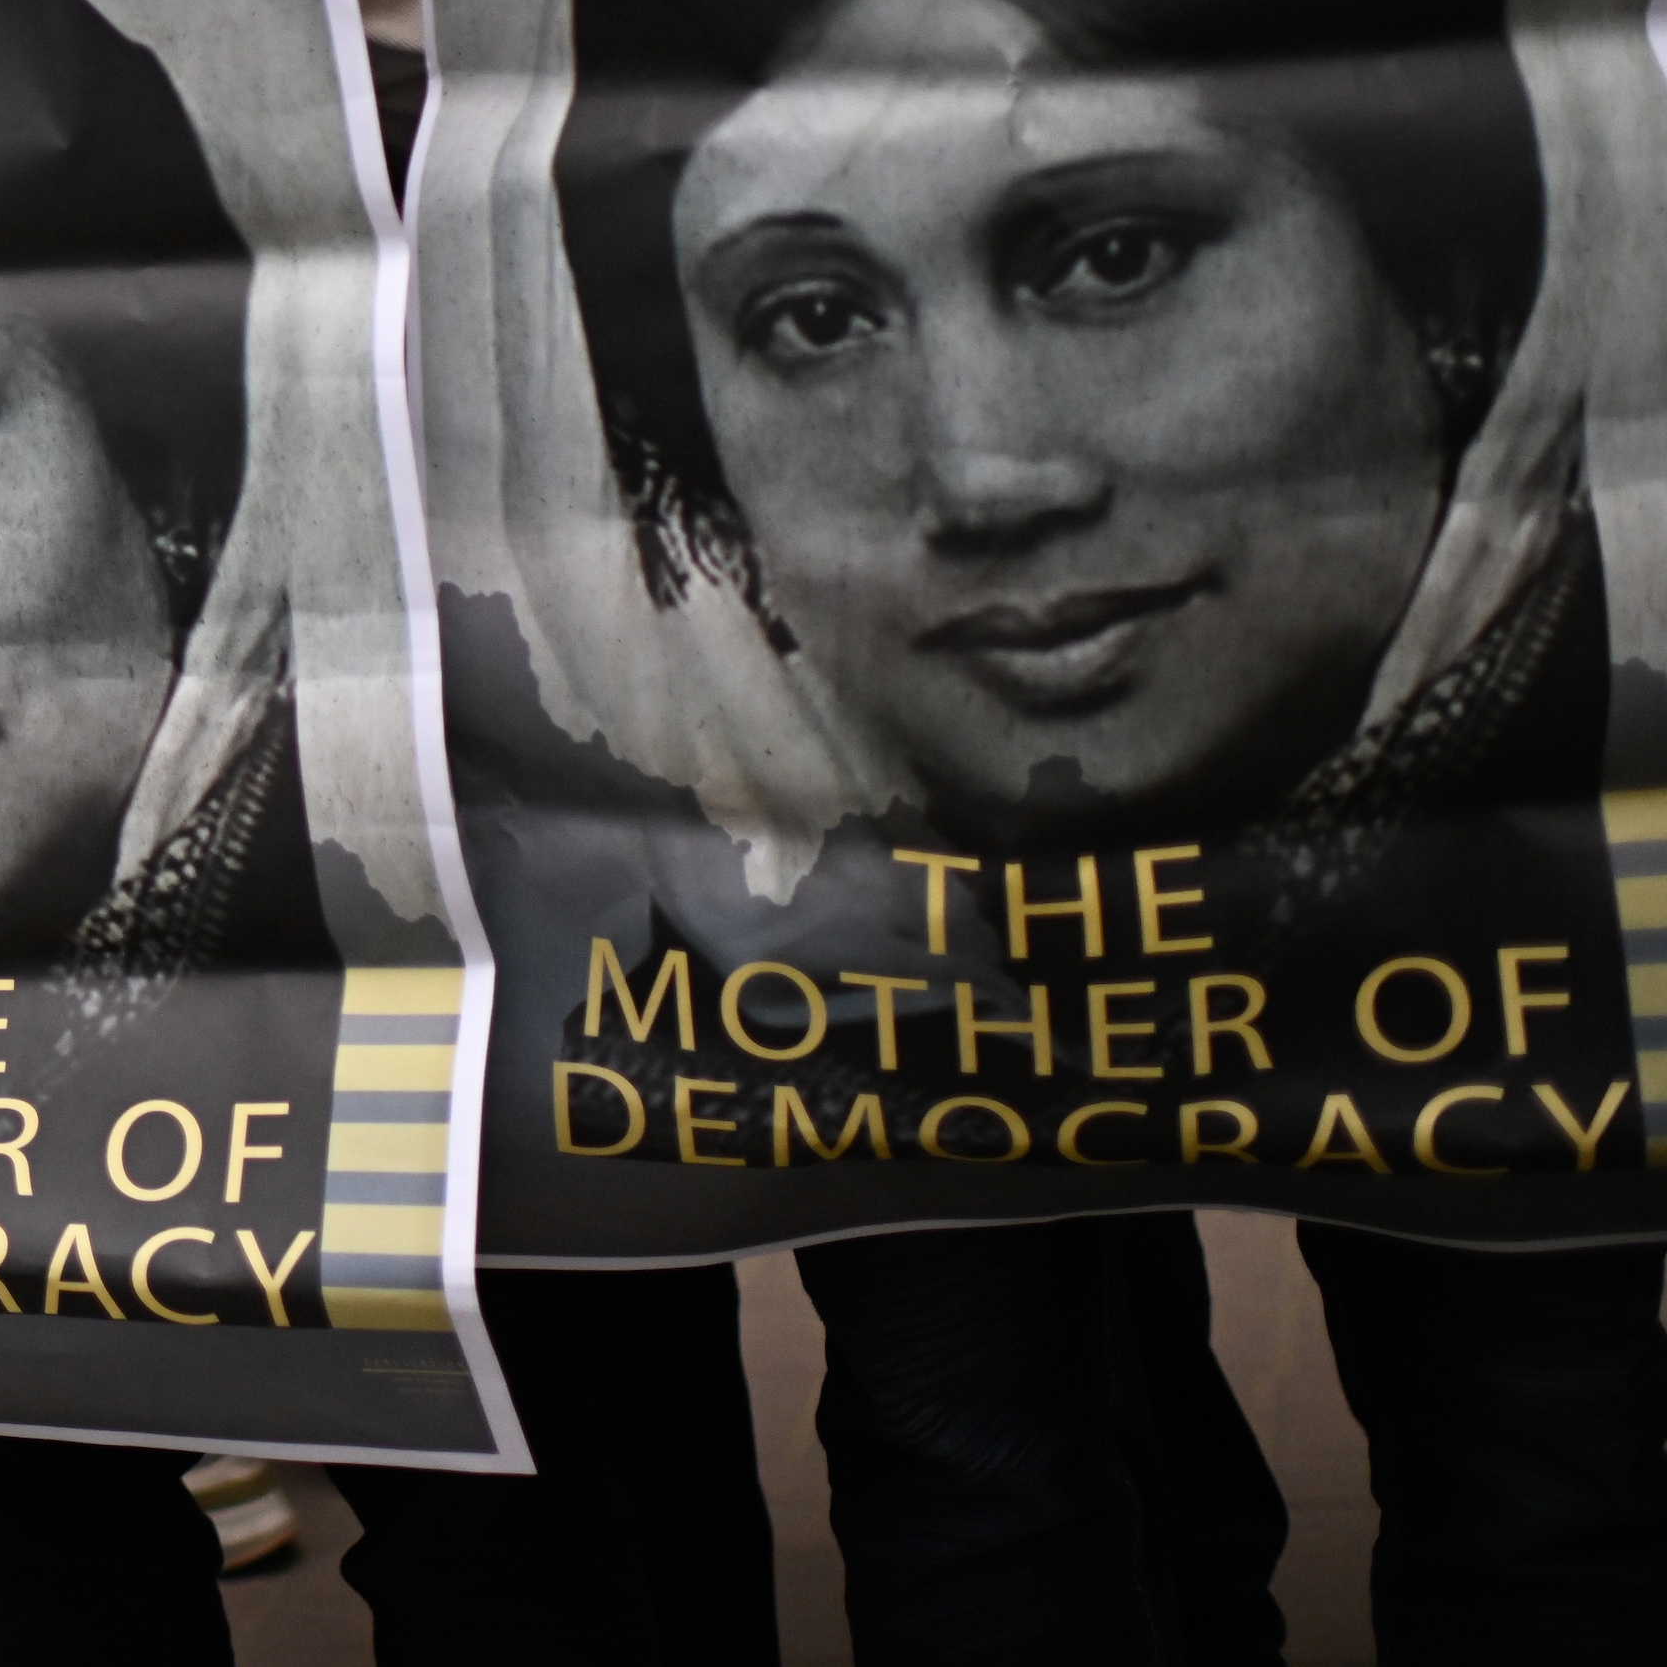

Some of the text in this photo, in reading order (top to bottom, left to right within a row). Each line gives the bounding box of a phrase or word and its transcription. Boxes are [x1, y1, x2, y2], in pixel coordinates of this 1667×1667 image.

[892, 844, 1215, 960] THE
[584, 937, 1571, 1080] MOTHER OF
[104, 1099, 291, 1204] OF
[552, 1060, 1631, 1174] DEMOCRACY
